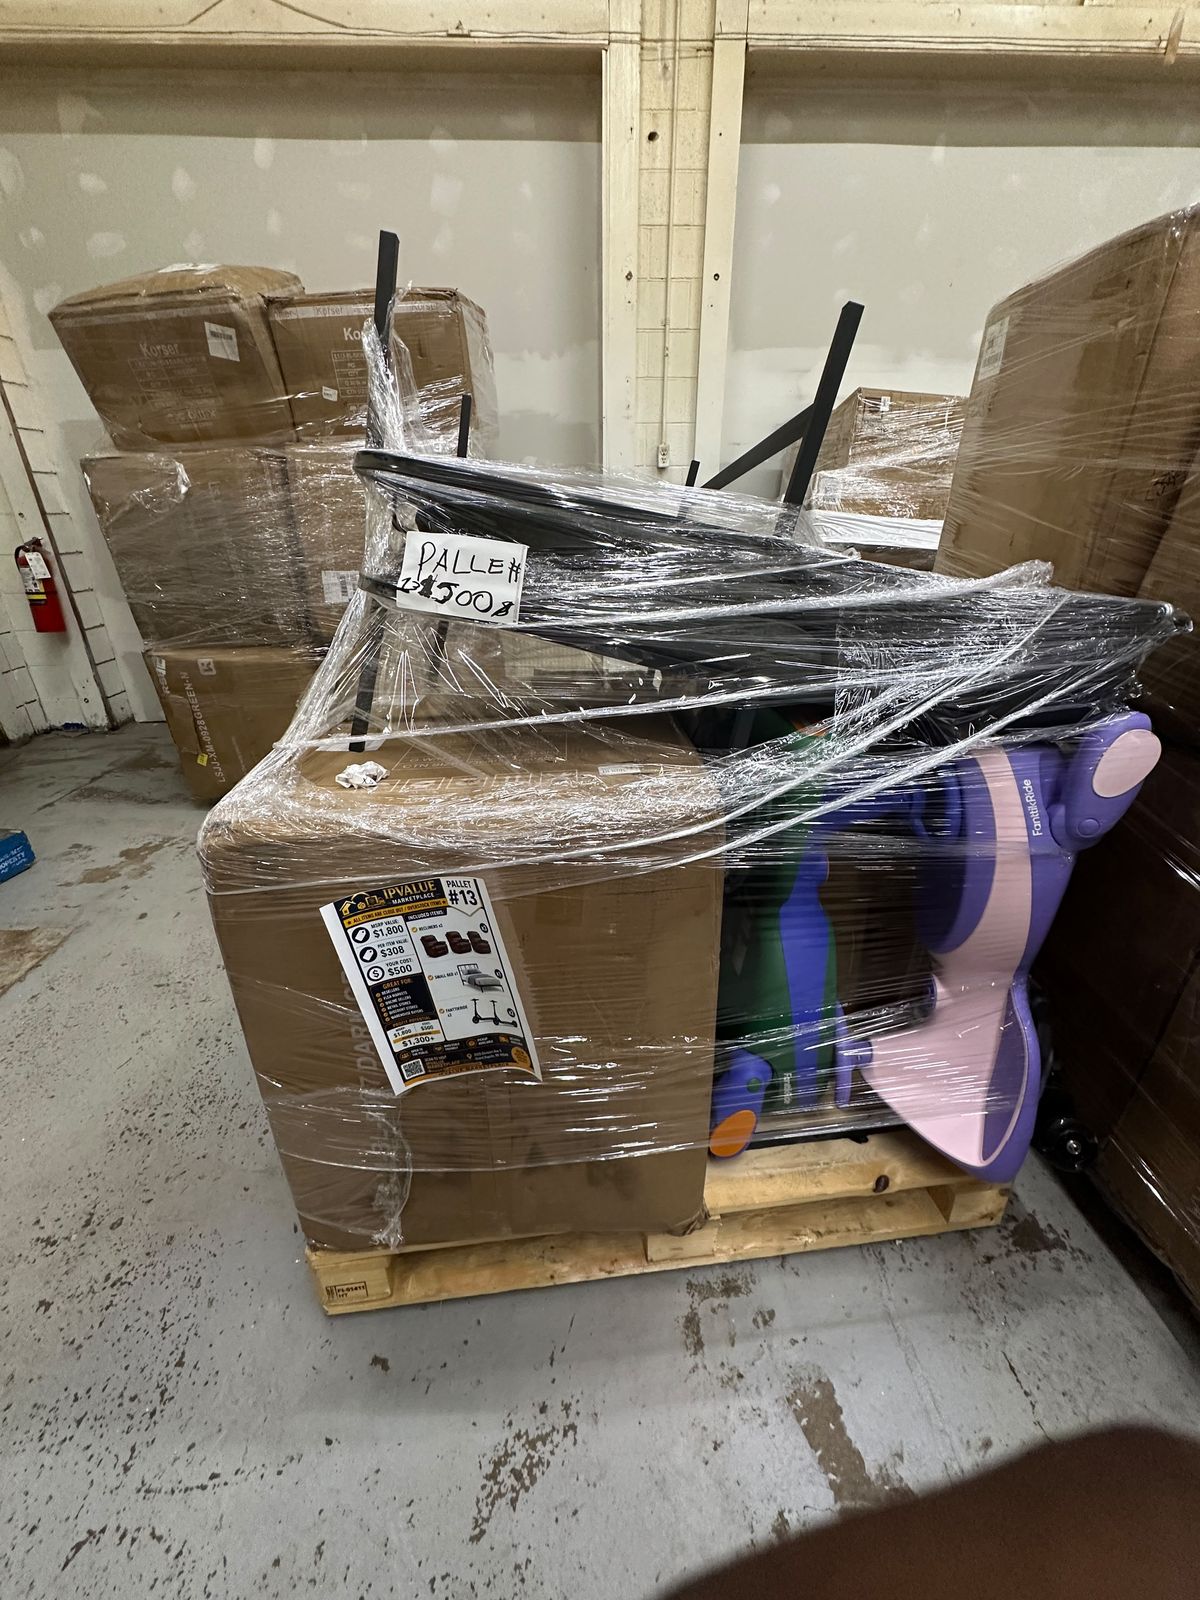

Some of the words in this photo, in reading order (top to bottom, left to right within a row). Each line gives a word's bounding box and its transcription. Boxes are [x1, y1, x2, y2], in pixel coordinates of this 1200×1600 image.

[140, 343, 179, 358] Korser
[1023, 779, 1043, 836] FanttikRide
[382, 880, 437, 900] IPVALUE
[446, 880, 472, 888] PALLET
[392, 892, 435, 905] MARKETPLACE
[448, 889, 478, 906] #13
[408, 912, 430, 920] INCLUDED
[373, 925, 404, 938] $1,800
[380, 945, 405, 958] $308
[387, 964, 413, 977] $500
[383, 980, 400, 989] GREAT
[393, 1029, 412, 1038] $1,800
[402, 1036, 434, 1047] $1,300+
